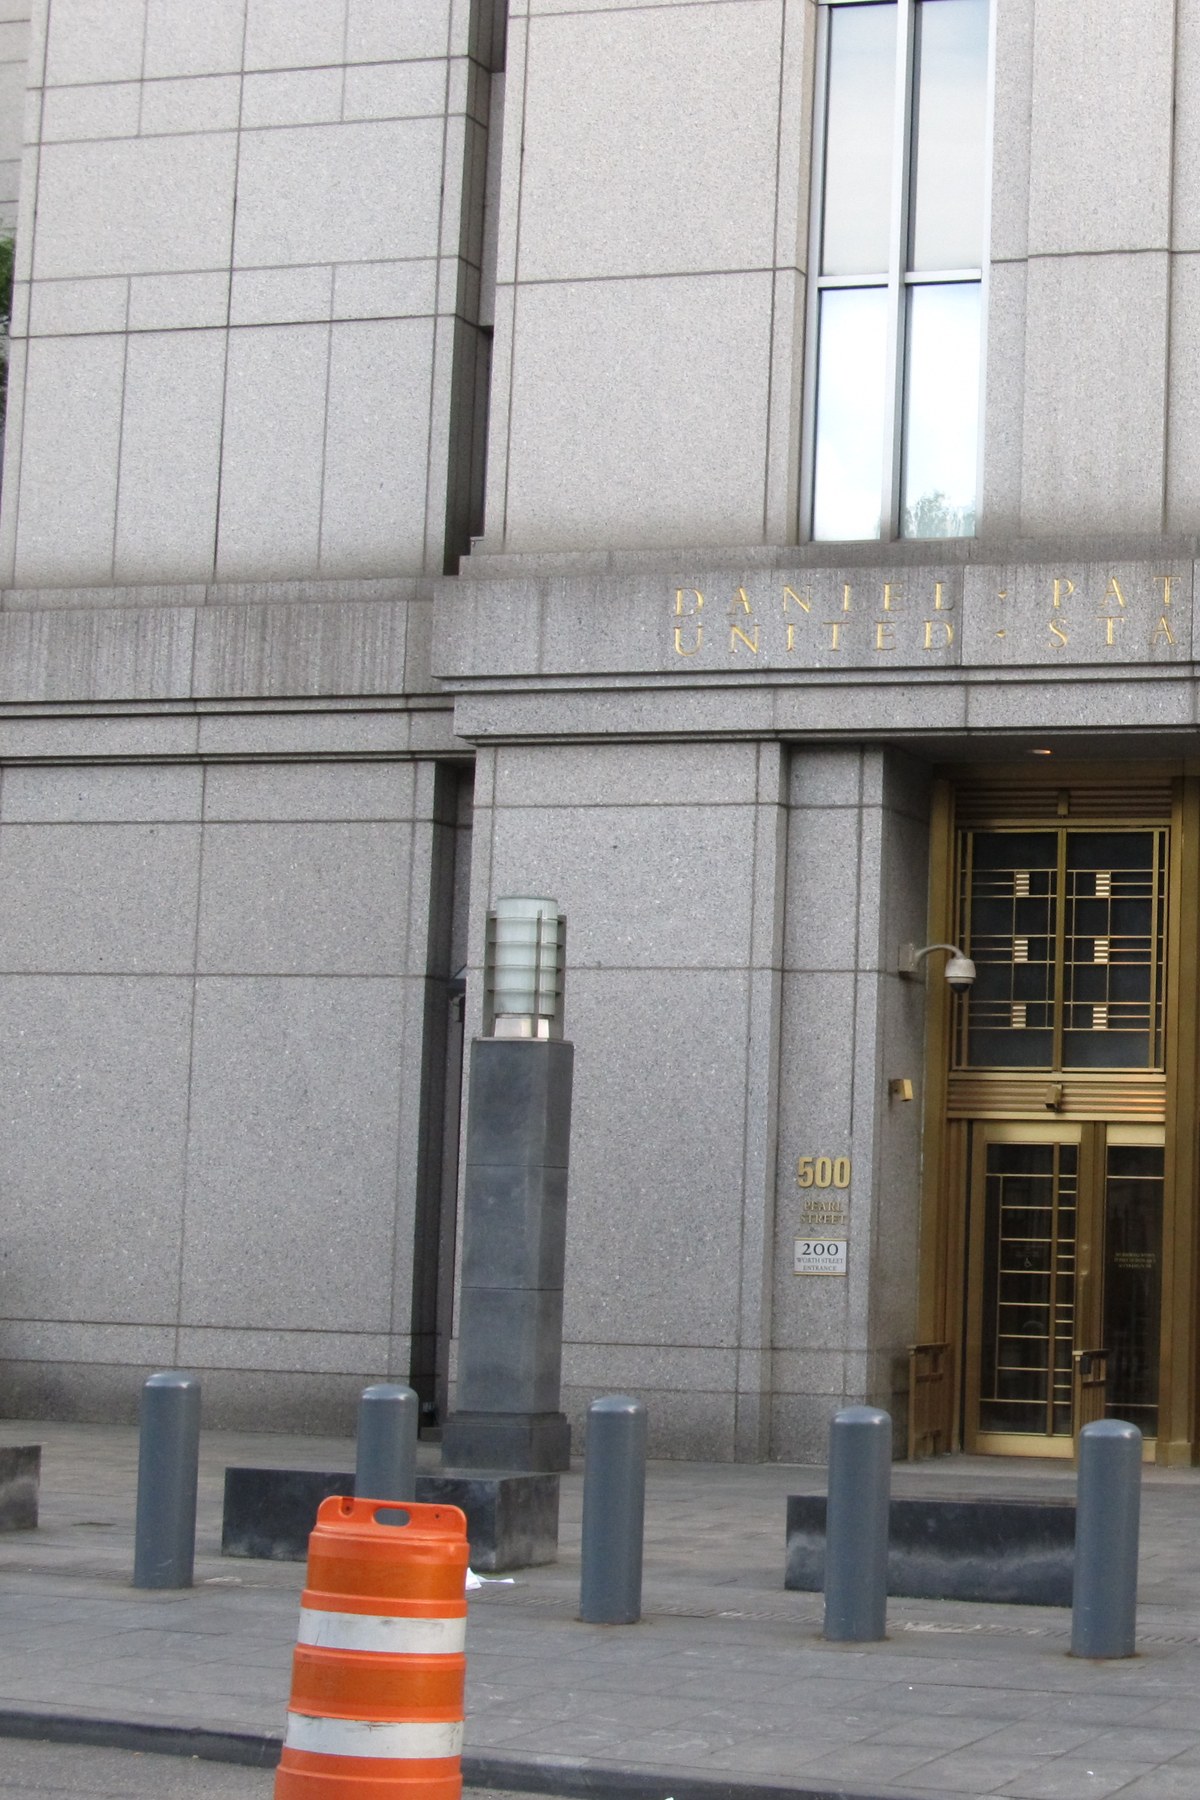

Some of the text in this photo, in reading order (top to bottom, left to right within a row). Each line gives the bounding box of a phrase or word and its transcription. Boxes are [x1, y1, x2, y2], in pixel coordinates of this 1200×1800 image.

[673, 580, 955, 618] DANIEL
[673, 620, 955, 657] UNITED
[797, 1155, 851, 1189] 500
[803, 1200, 843, 1213] PEARL
[800, 1213, 847, 1226] STREET
[802, 1242, 839, 1256] 200
